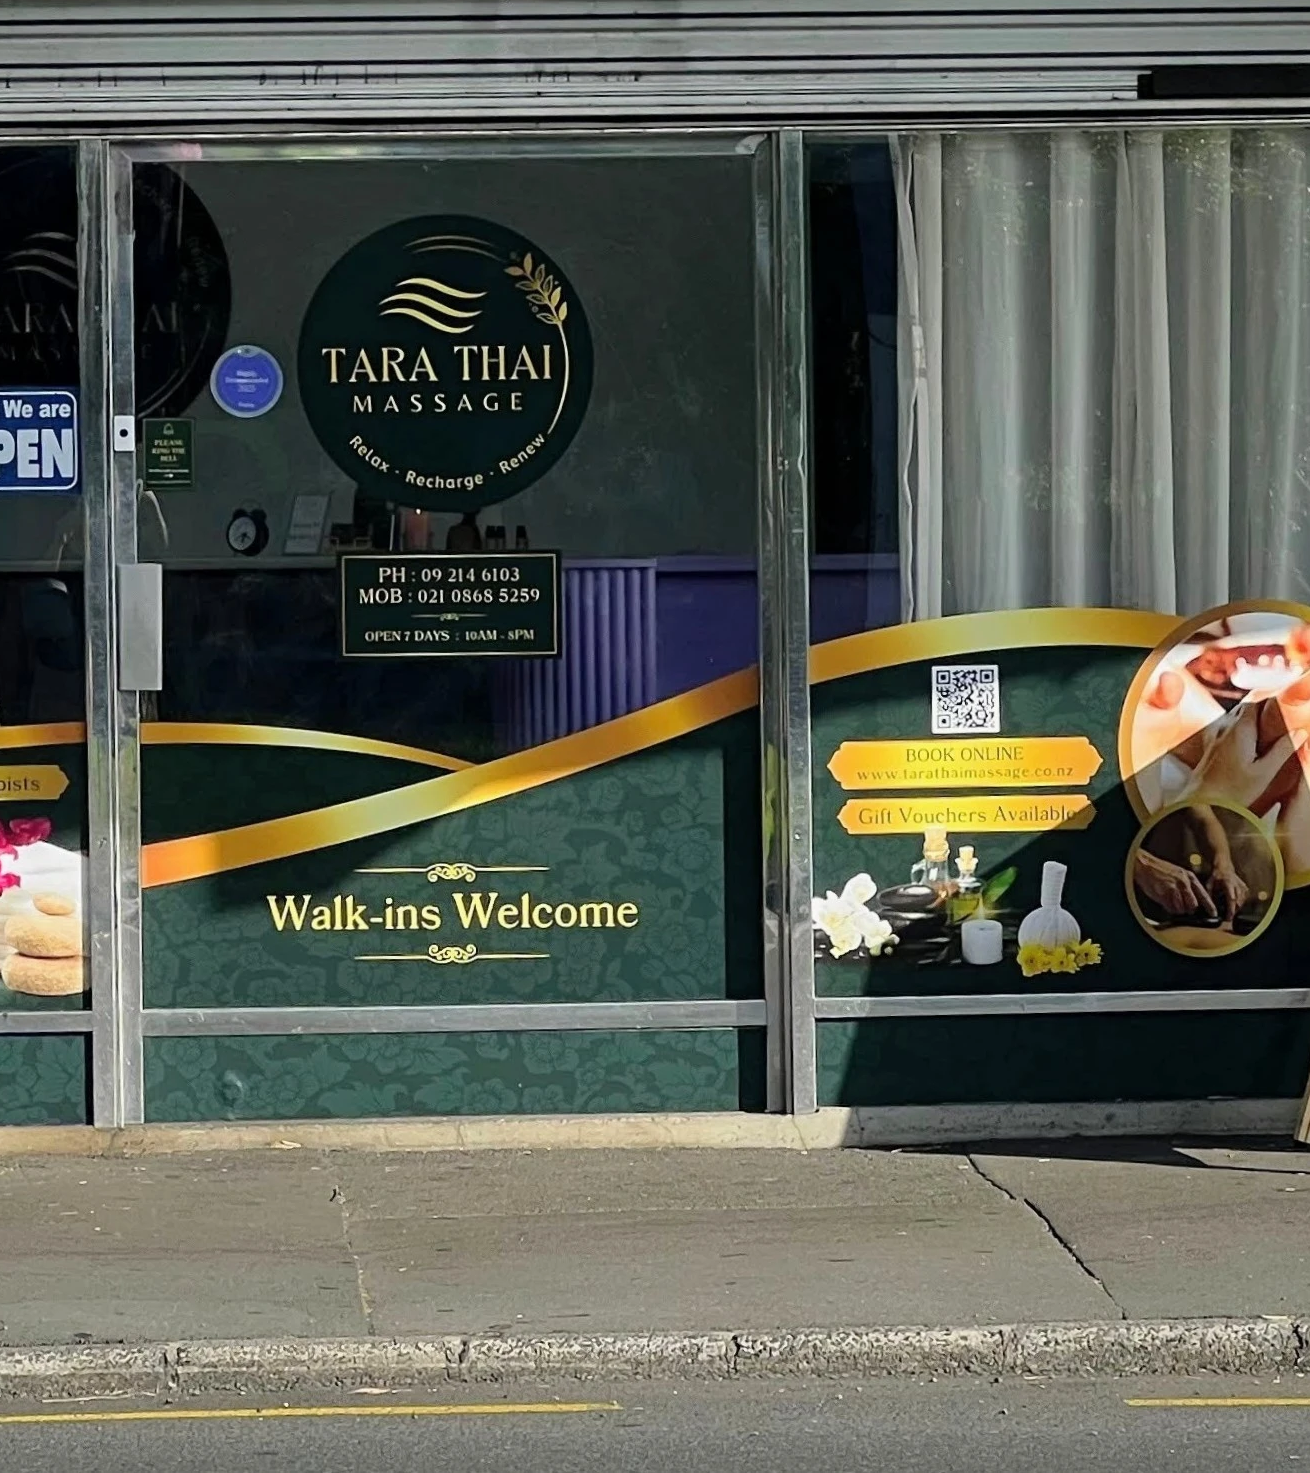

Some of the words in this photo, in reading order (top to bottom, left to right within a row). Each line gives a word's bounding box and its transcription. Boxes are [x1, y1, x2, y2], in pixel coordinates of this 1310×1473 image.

[321, 346, 439, 384] TARA
[453, 344, 552, 382] THAI
[3, 399, 35, 419] We
[38, 402, 71, 419] are
[352, 392, 523, 413] MASSAGE
[348, 434, 391, 474] Relax
[405, 469, 484, 491] Recharge
[498, 432, 546, 475] Renew
[378, 566, 407, 584] PH
[421, 567, 442, 583] 09
[448, 567, 475, 583] 214
[481, 566, 521, 583] 6103
[359, 587, 403, 605] MOB
[417, 588, 445, 604] 021
[451, 588, 494, 604] 0868
[498, 587, 541, 603] 5259
[364, 630, 401, 642] OPEN
[414, 630, 451, 642] DAYS
[464, 629, 498, 641] 10AM
[507, 629, 535, 641] 8PM
[905, 747, 955, 763] BOOK
[960, 746, 1024, 762] ONLINE
[857, 766, 1074, 781] www.tarathaimassage.co.nz
[858, 807, 893, 826] Gift
[898, 806, 987, 825] Vouchers
[993, 803, 1078, 823] Available
[265, 893, 442, 932] Walk-ins
[451, 891, 640, 931] Welcome
